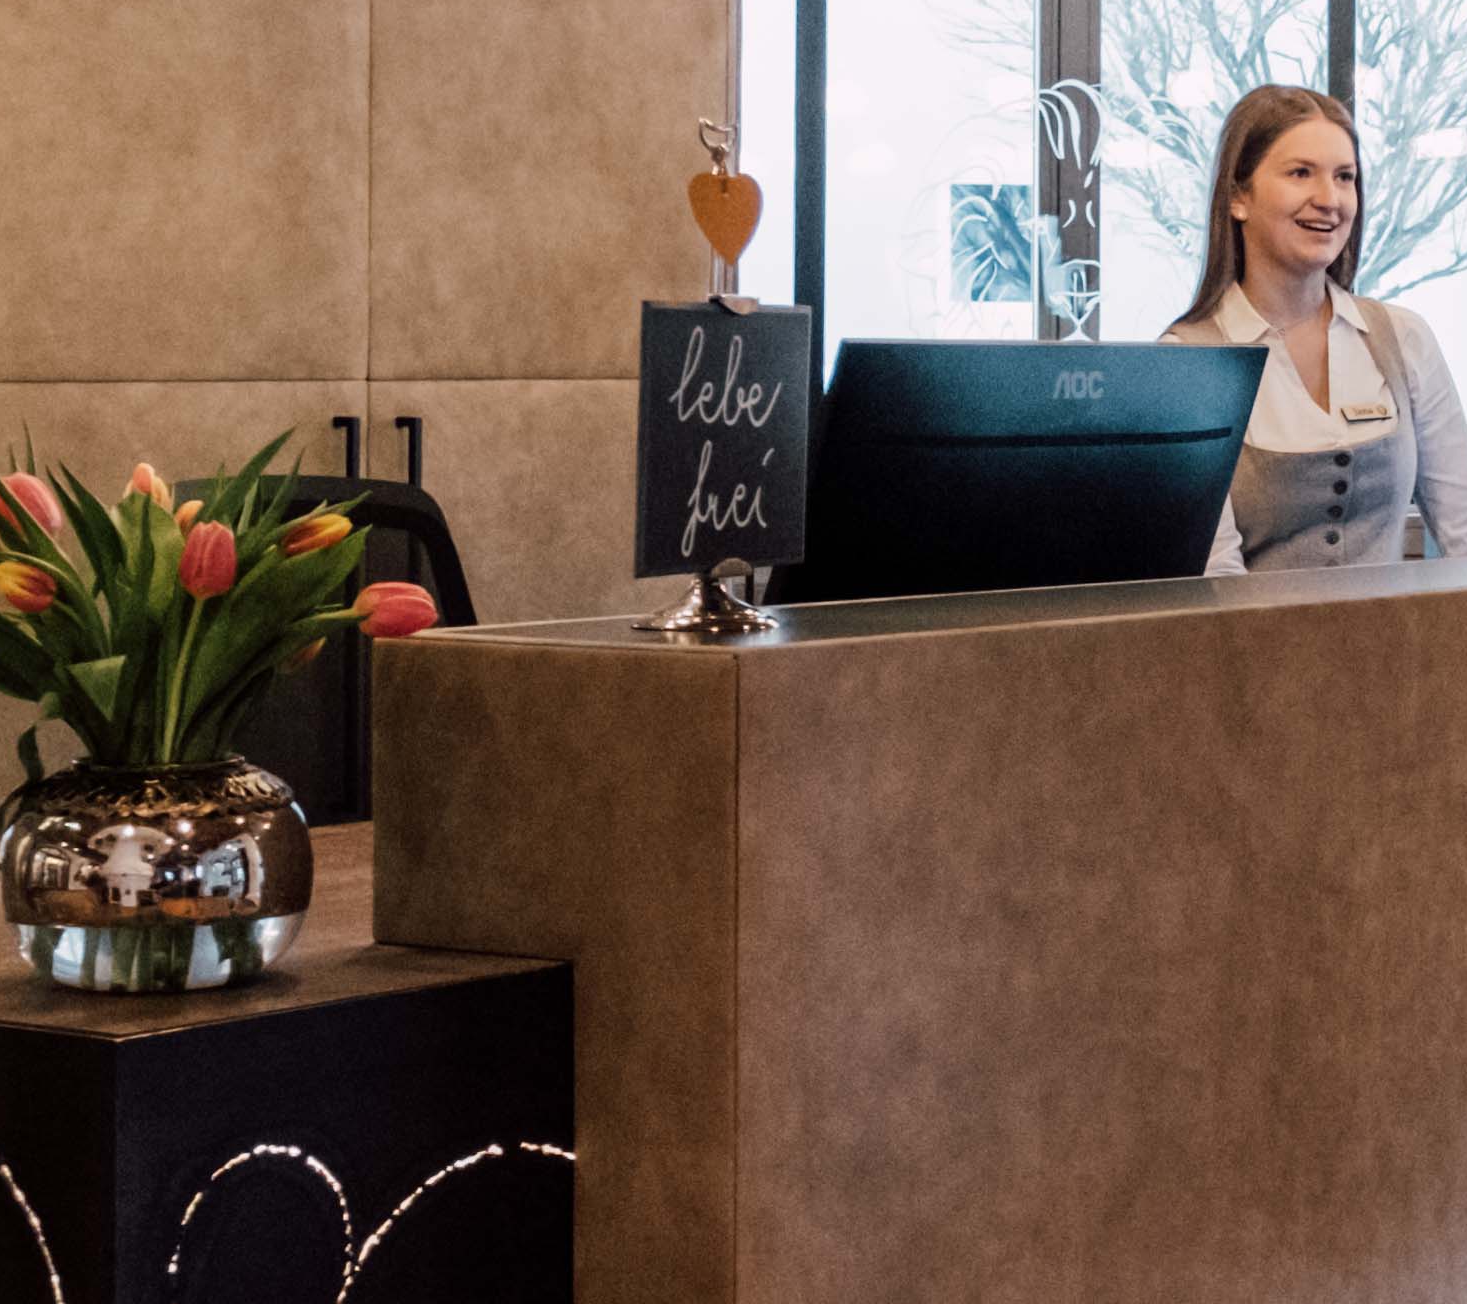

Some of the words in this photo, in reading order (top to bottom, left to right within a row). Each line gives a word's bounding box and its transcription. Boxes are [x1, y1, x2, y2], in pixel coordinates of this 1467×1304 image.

[669, 325, 782, 427] lebe
[1053, 369, 1105, 400] AOC
[680, 439, 775, 557] frei
